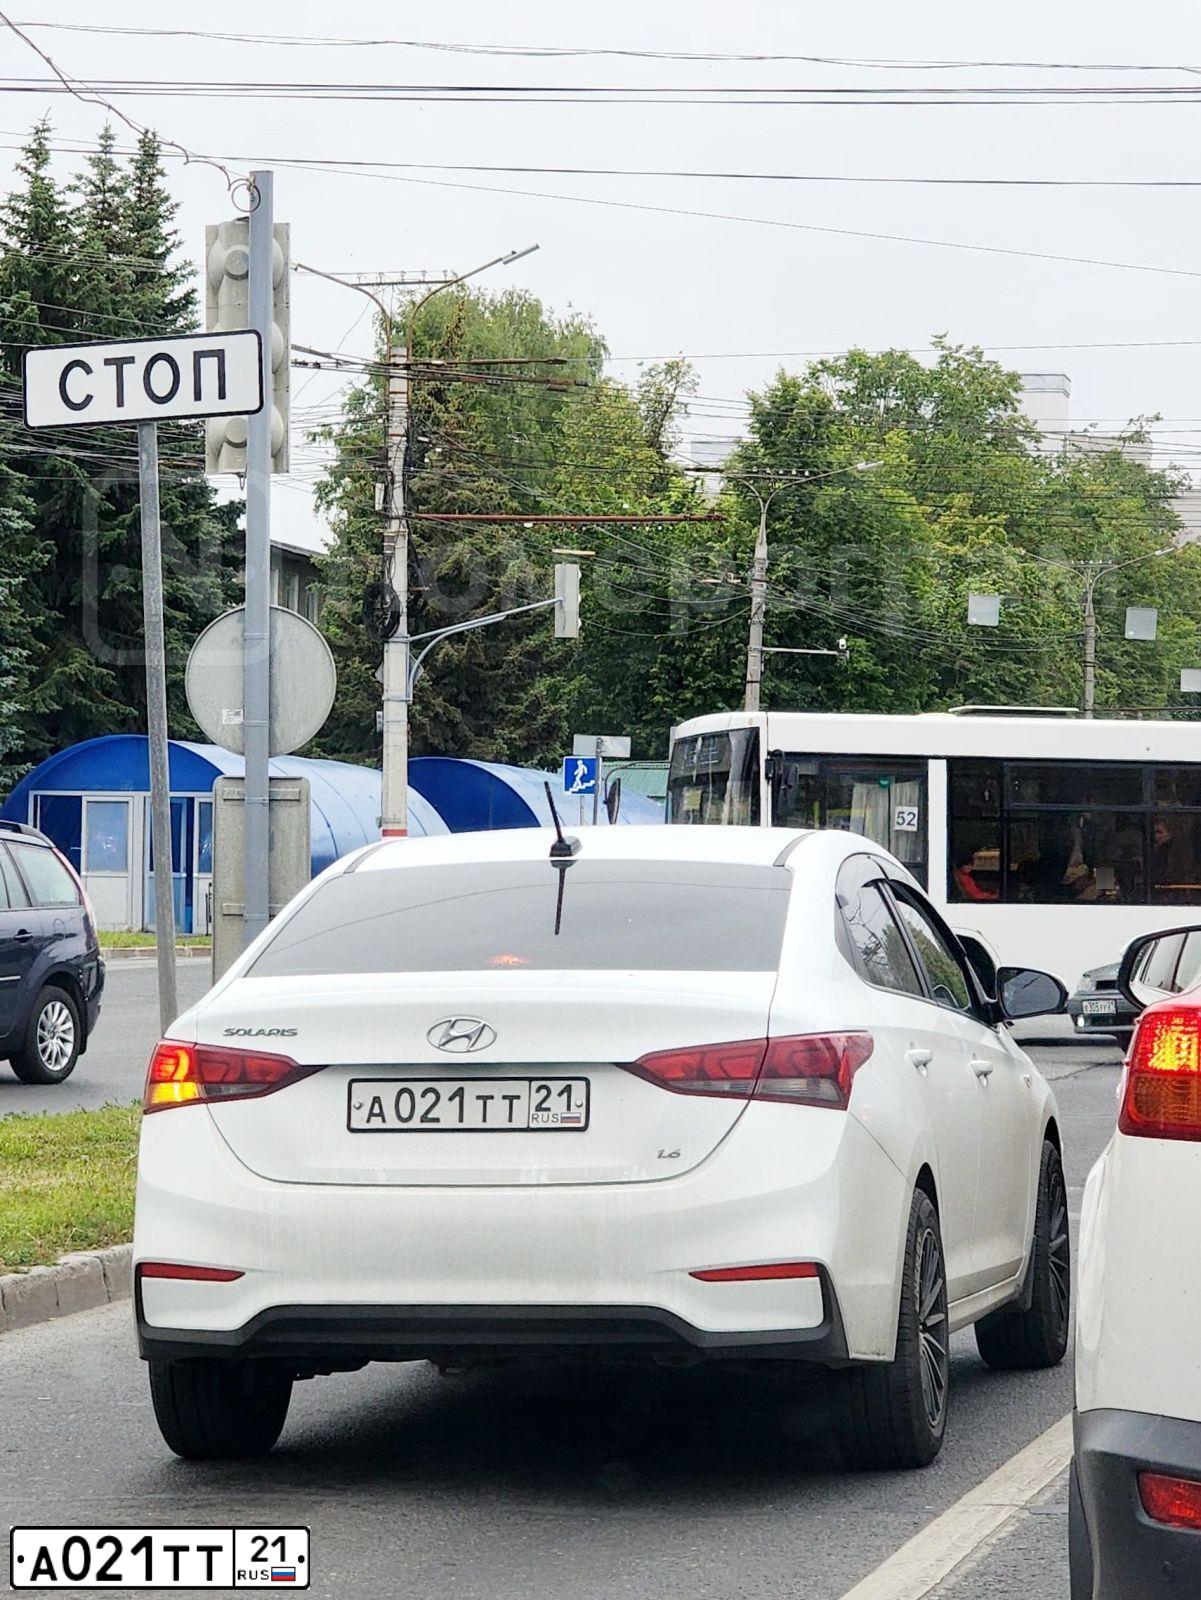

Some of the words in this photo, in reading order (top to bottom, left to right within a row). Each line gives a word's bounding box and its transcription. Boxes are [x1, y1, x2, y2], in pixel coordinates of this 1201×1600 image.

[59, 349, 226, 412] СТОП
[896, 811, 916, 827] 52
[222, 1028, 298, 1037] SOLARIS
[366, 1086, 521, 1123] А021ТТ
[534, 1084, 573, 1112] 21
[531, 1113, 560, 1123] RUS
